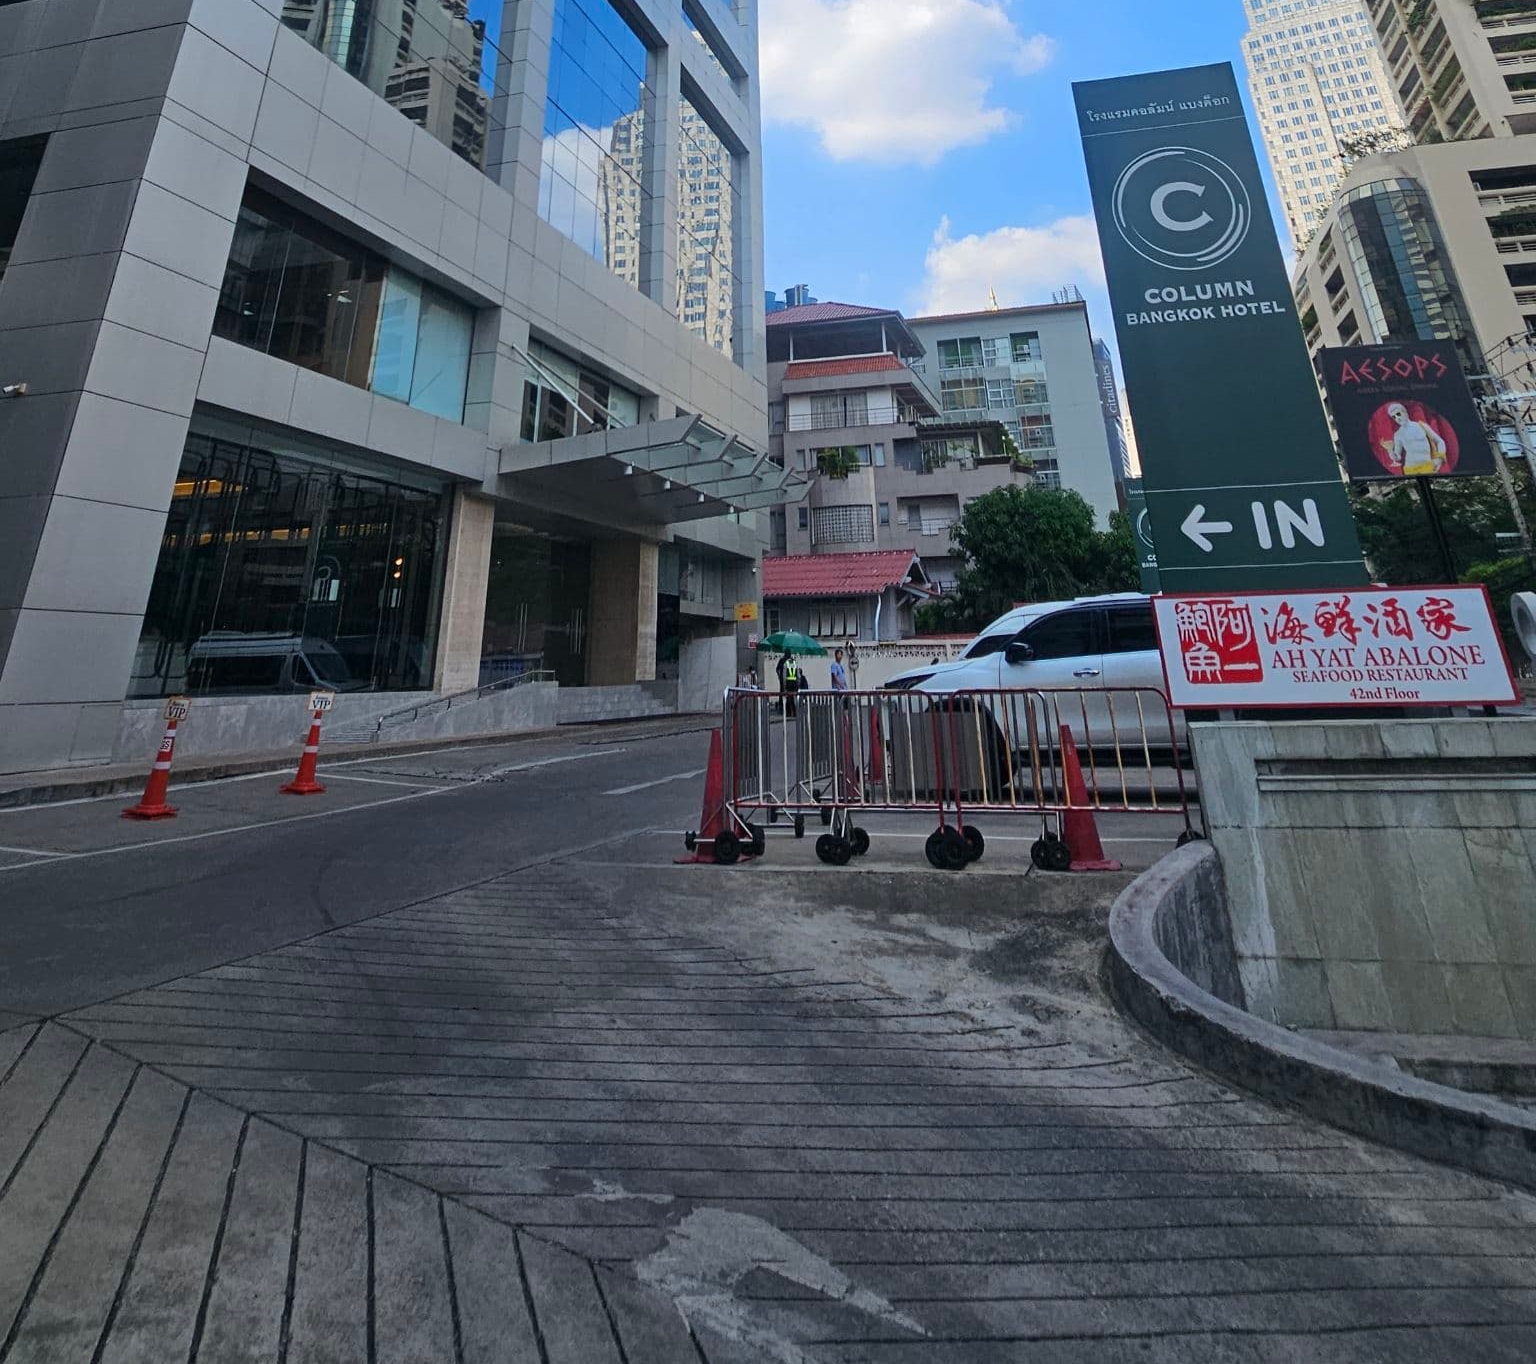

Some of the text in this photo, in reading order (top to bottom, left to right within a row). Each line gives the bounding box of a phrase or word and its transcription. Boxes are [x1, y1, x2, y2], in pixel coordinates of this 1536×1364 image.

[1086, 100, 1175, 122] โรงแรมคอลัมน์
[1150, 181, 1214, 232] C
[1144, 280, 1255, 304] COLUMN
[1126, 301, 1286, 326] BANGKOK HOTEL
[1341, 353, 1448, 385] AESOPS
[1102, 364, 1118, 413] citadines
[1251, 498, 1325, 550] IN
[1261, 595, 1473, 646] 海鮮酒家
[1272, 645, 1486, 669] AH YAT ABALONE
[1293, 667, 1469, 683] SEAFOOD RESTAURANT
[312, 699, 331, 709] VIP
[1350, 686, 1420, 700] 42nd Floor
[168, 706, 186, 718] VIP
